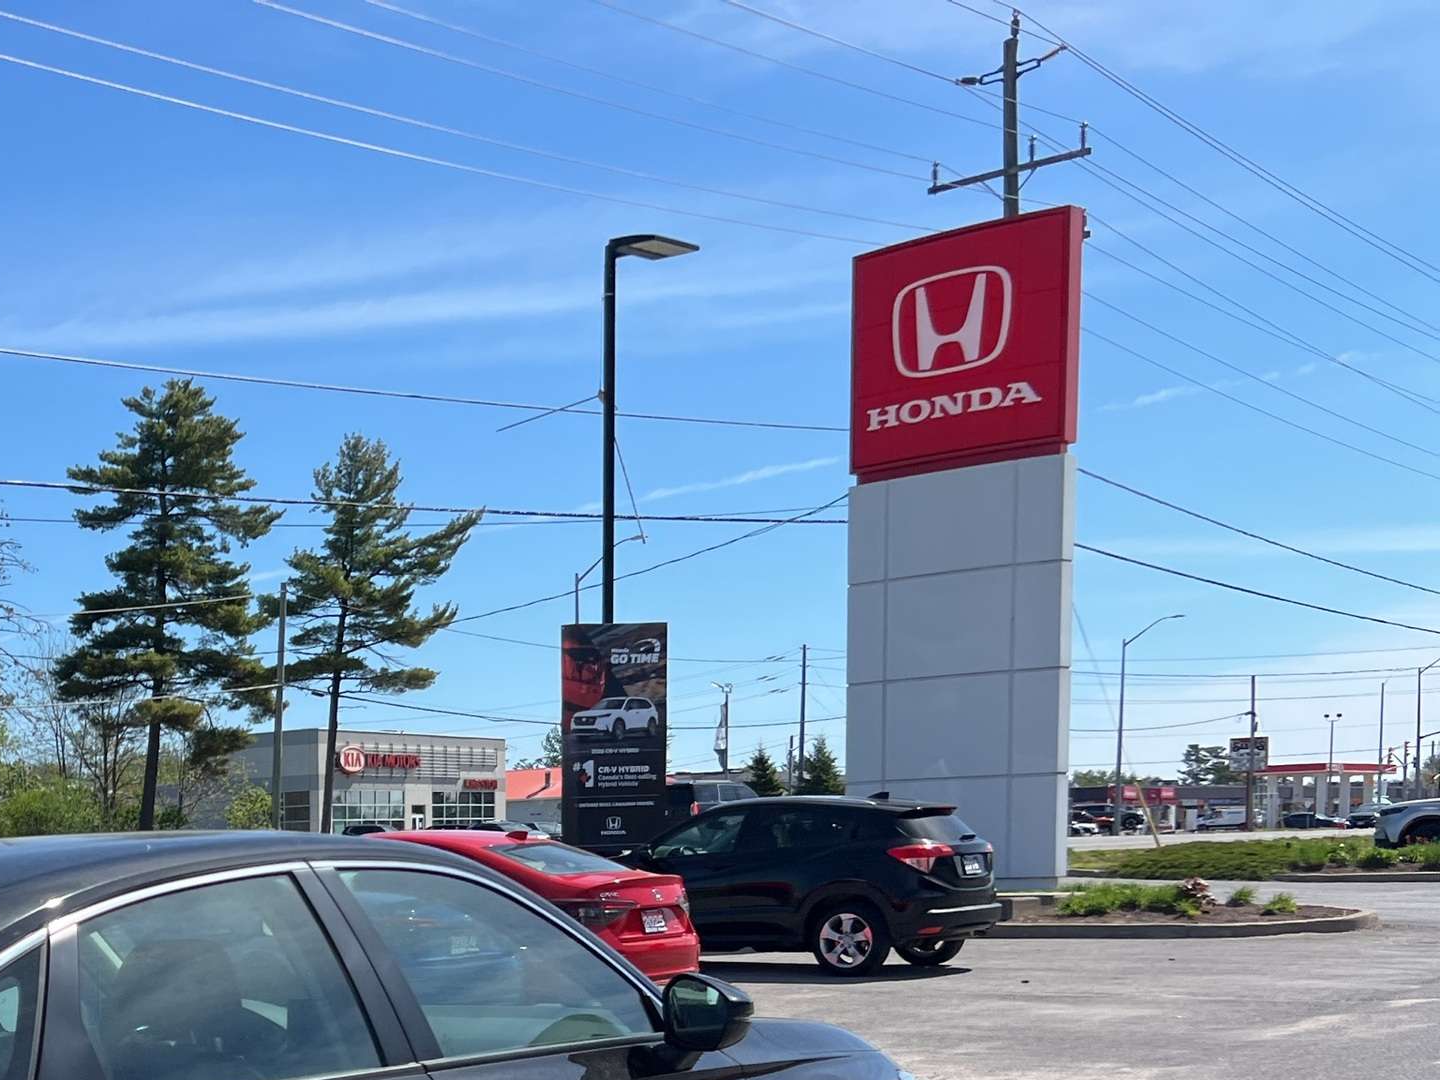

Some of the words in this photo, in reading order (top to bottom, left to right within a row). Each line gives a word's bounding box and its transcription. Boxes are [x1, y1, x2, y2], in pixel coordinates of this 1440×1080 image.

[866, 381, 1042, 431] HONDA
[610, 654, 629, 664] GO
[630, 653, 660, 664] TIME
[343, 752, 361, 767] KIA
[367, 754, 383, 768] KIA
[384, 754, 421, 768] MOTORS
[619, 765, 650, 773] HYBRID
